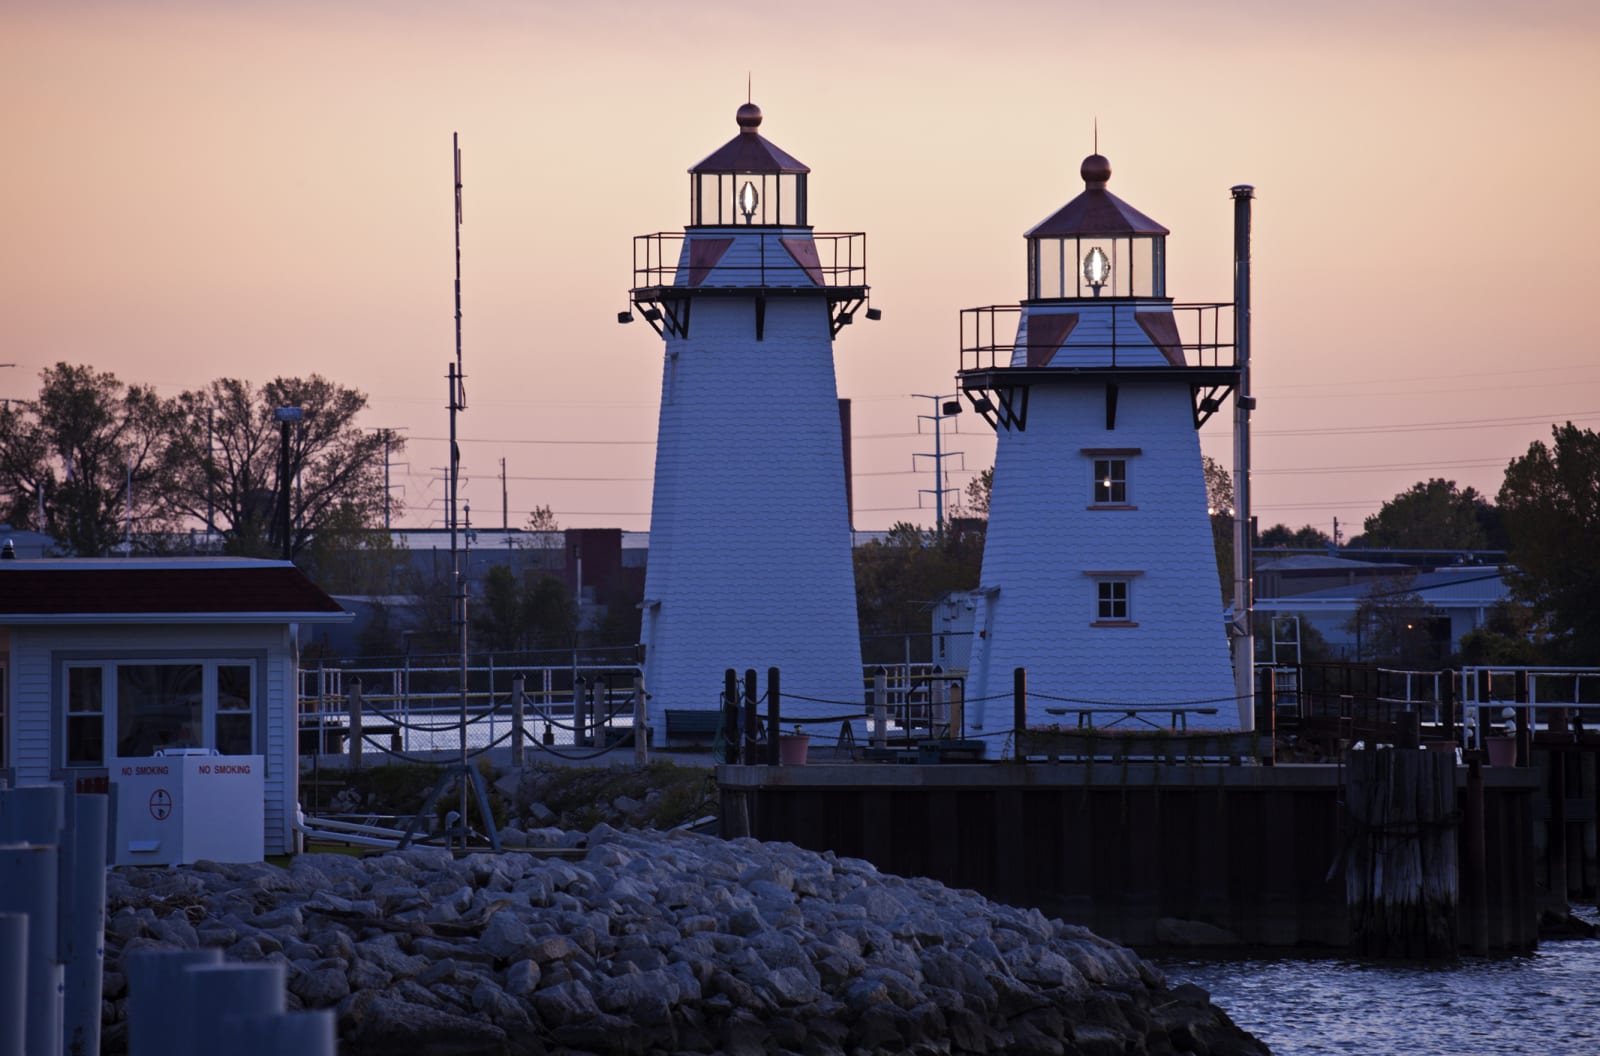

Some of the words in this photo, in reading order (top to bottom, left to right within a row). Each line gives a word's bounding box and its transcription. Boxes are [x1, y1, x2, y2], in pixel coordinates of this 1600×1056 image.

[122, 767, 132, 776] NO
[135, 766, 169, 775] SMOKING
[199, 765, 210, 774] NO
[214, 765, 250, 774] SMOKING
